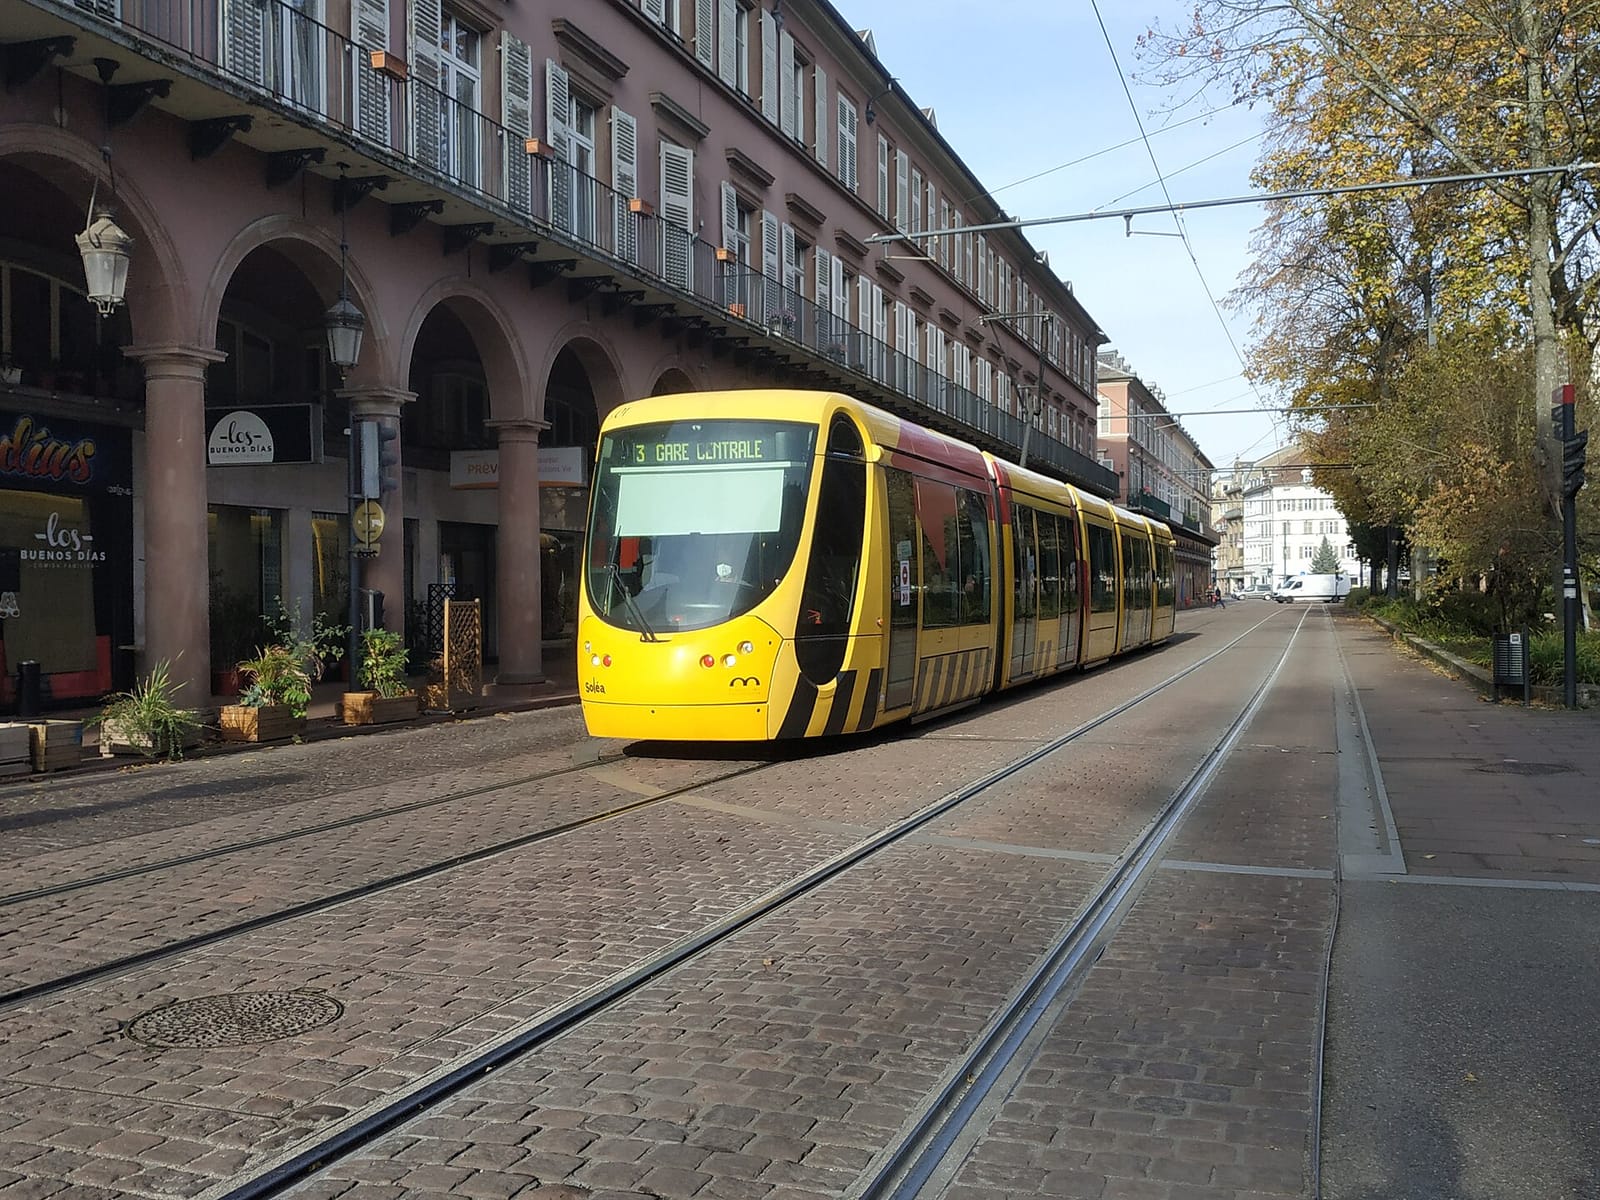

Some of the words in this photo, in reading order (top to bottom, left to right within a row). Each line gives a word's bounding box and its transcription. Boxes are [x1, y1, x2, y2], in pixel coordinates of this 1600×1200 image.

[210, 446, 246, 454] BUENOS
[636, 444, 645, 462] 3
[656, 443, 690, 461] GARE
[20, 549, 72, 560] BUENOS
[78, 549, 106, 561] DÍAS
[585, 677, 606, 694] Soléa
